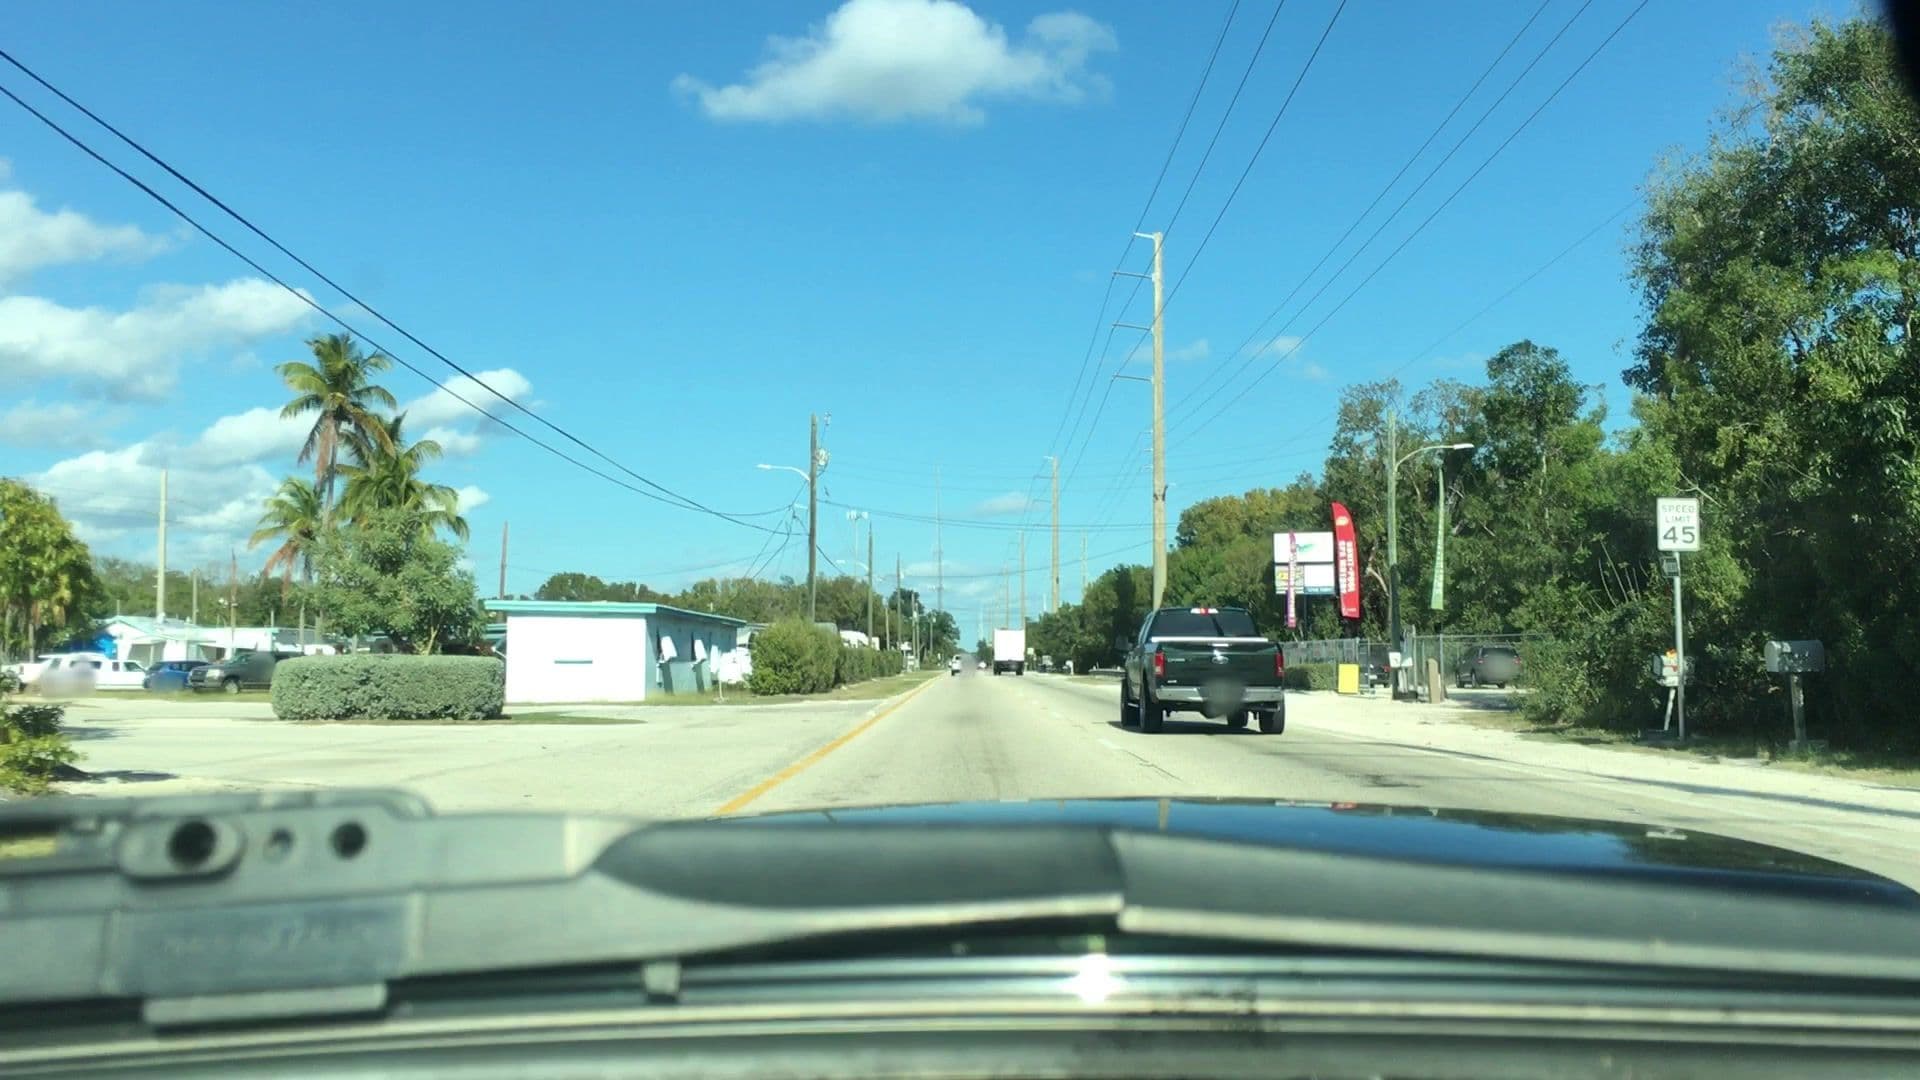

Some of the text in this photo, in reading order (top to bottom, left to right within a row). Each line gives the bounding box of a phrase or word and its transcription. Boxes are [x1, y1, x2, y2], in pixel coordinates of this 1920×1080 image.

[1661, 504, 1695, 513] SPEED
[1665, 515, 1691, 523] LIMIT
[1663, 526, 1695, 544] 45
